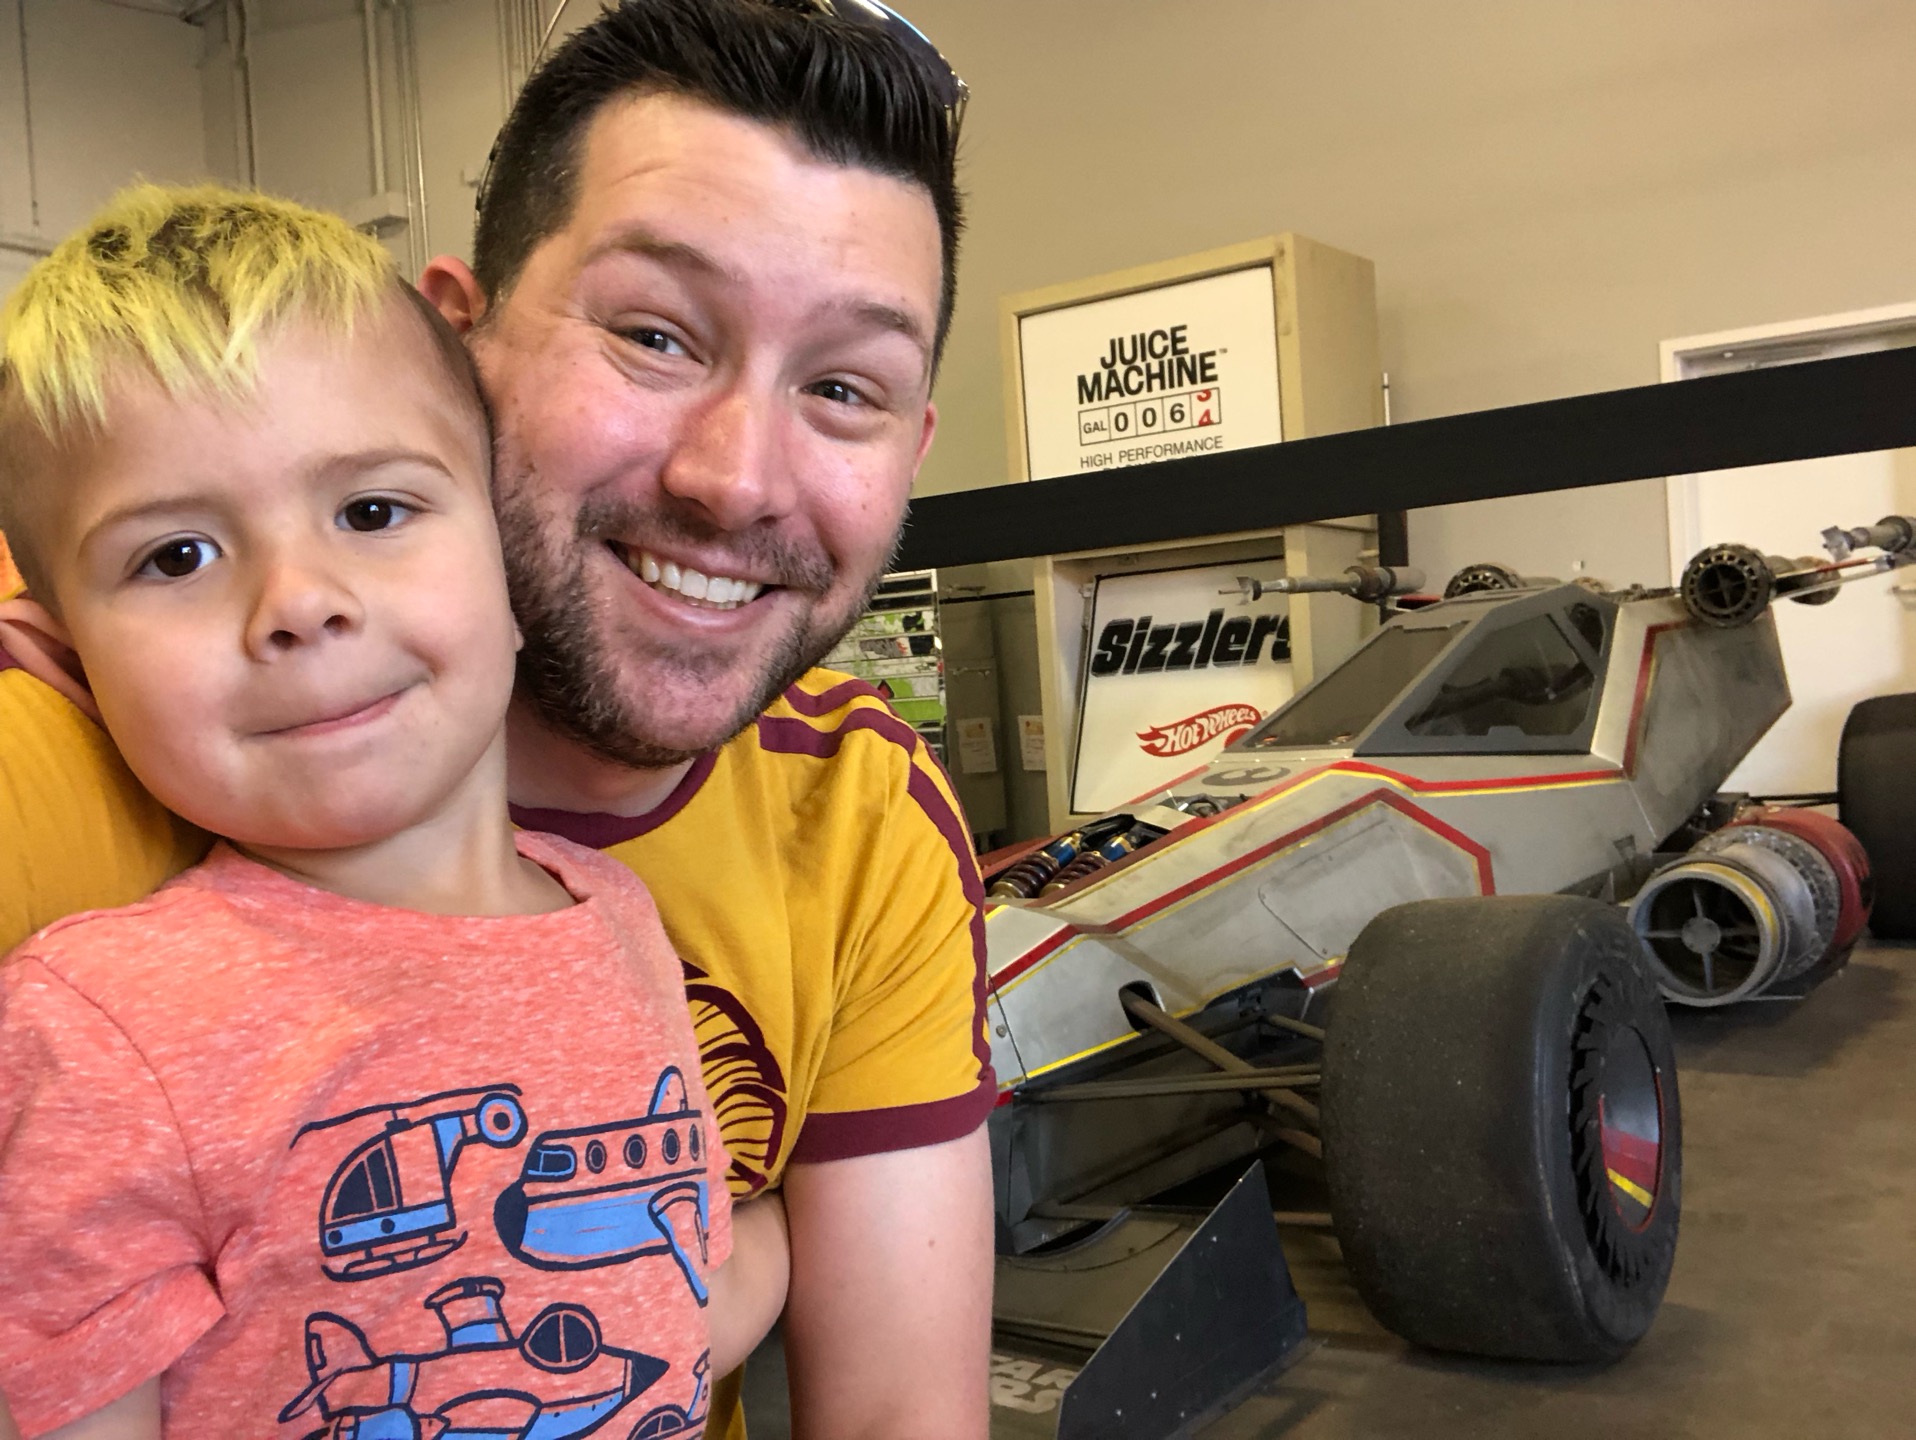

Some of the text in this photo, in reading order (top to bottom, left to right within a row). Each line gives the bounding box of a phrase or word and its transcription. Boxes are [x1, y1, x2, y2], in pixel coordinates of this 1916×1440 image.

[1100, 324, 1189, 370] JUICE
[1077, 350, 1219, 405] MACHINE
[1083, 419, 1108, 434] GAL
[1080, 452, 1113, 469] HIGH
[1118, 435, 1224, 463] PERFORMANCE
